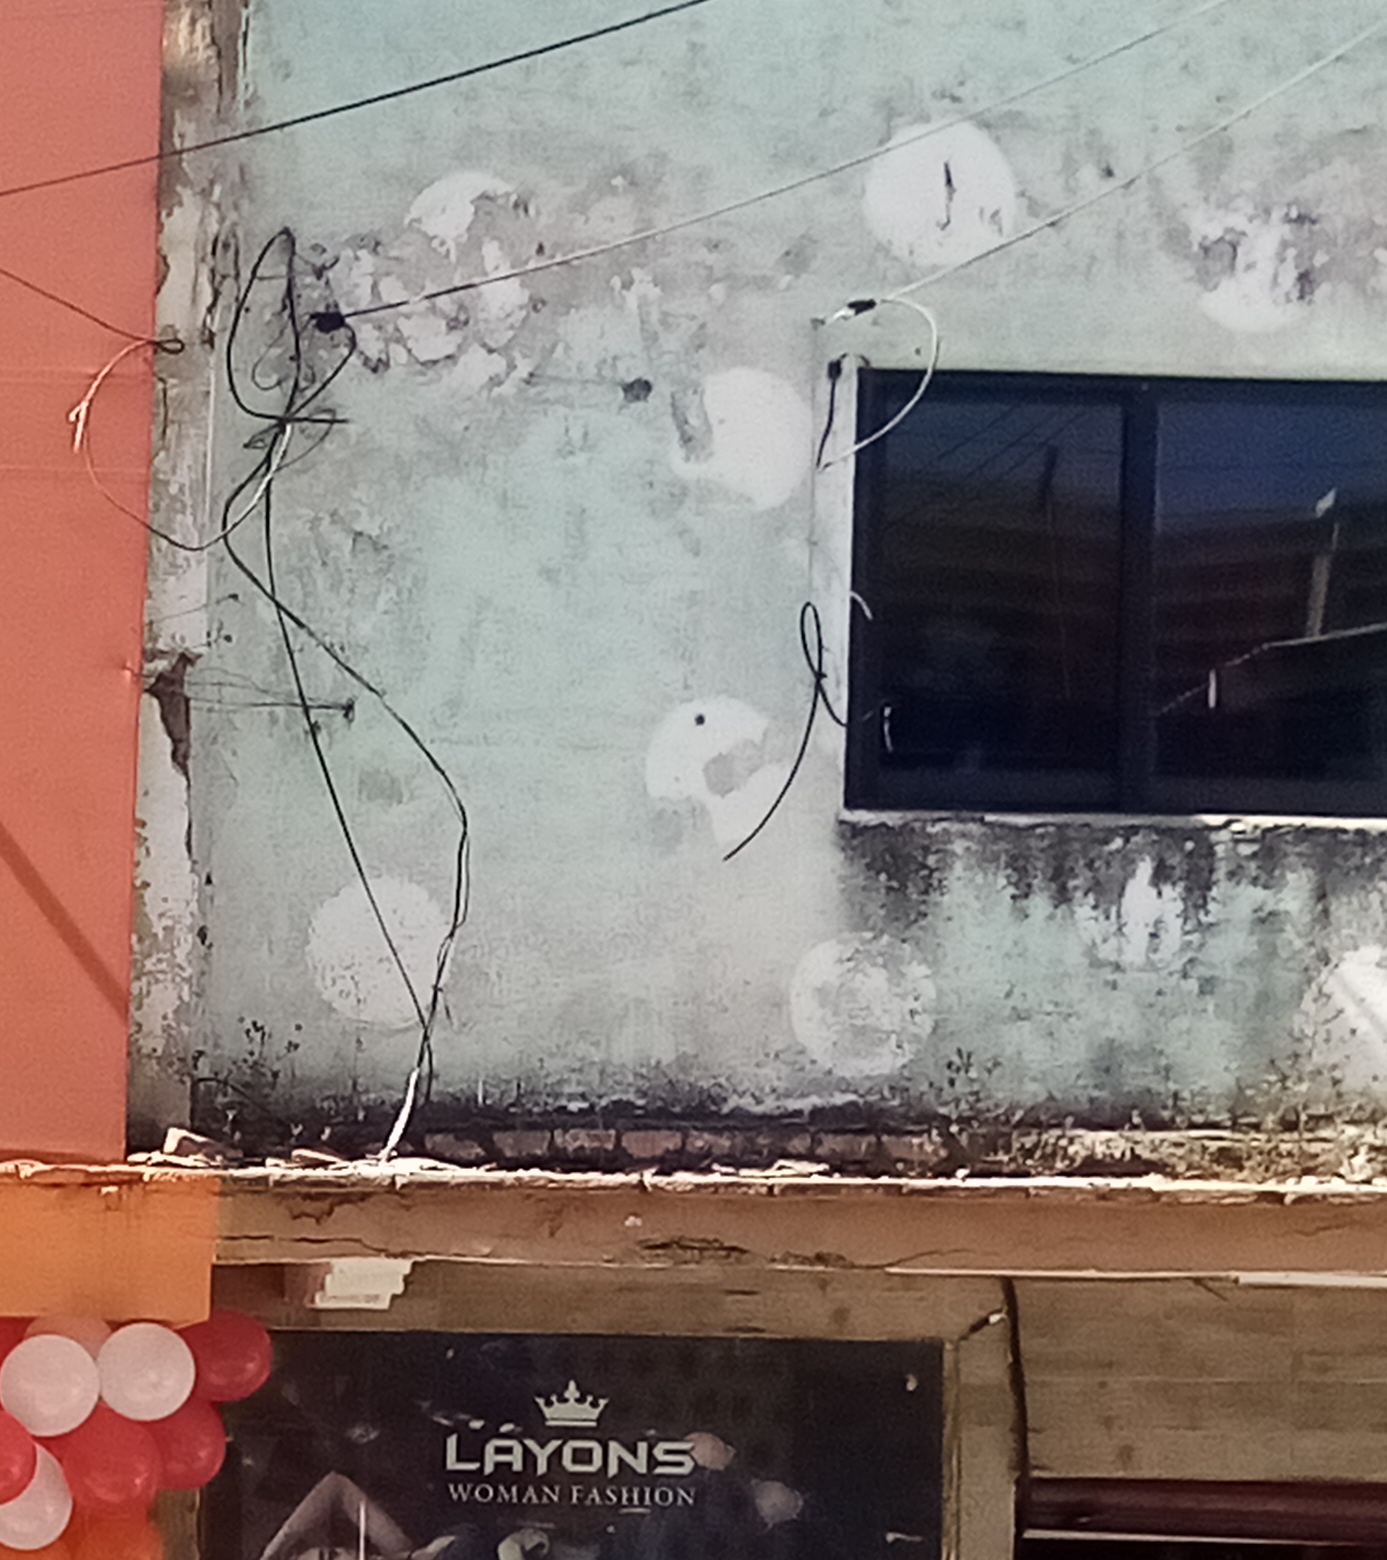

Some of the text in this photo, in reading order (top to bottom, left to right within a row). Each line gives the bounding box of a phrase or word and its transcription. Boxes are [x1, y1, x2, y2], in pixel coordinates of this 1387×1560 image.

[445, 1432, 696, 1478] LAYONS
[448, 1482, 697, 1507] WOMAN FASHION
